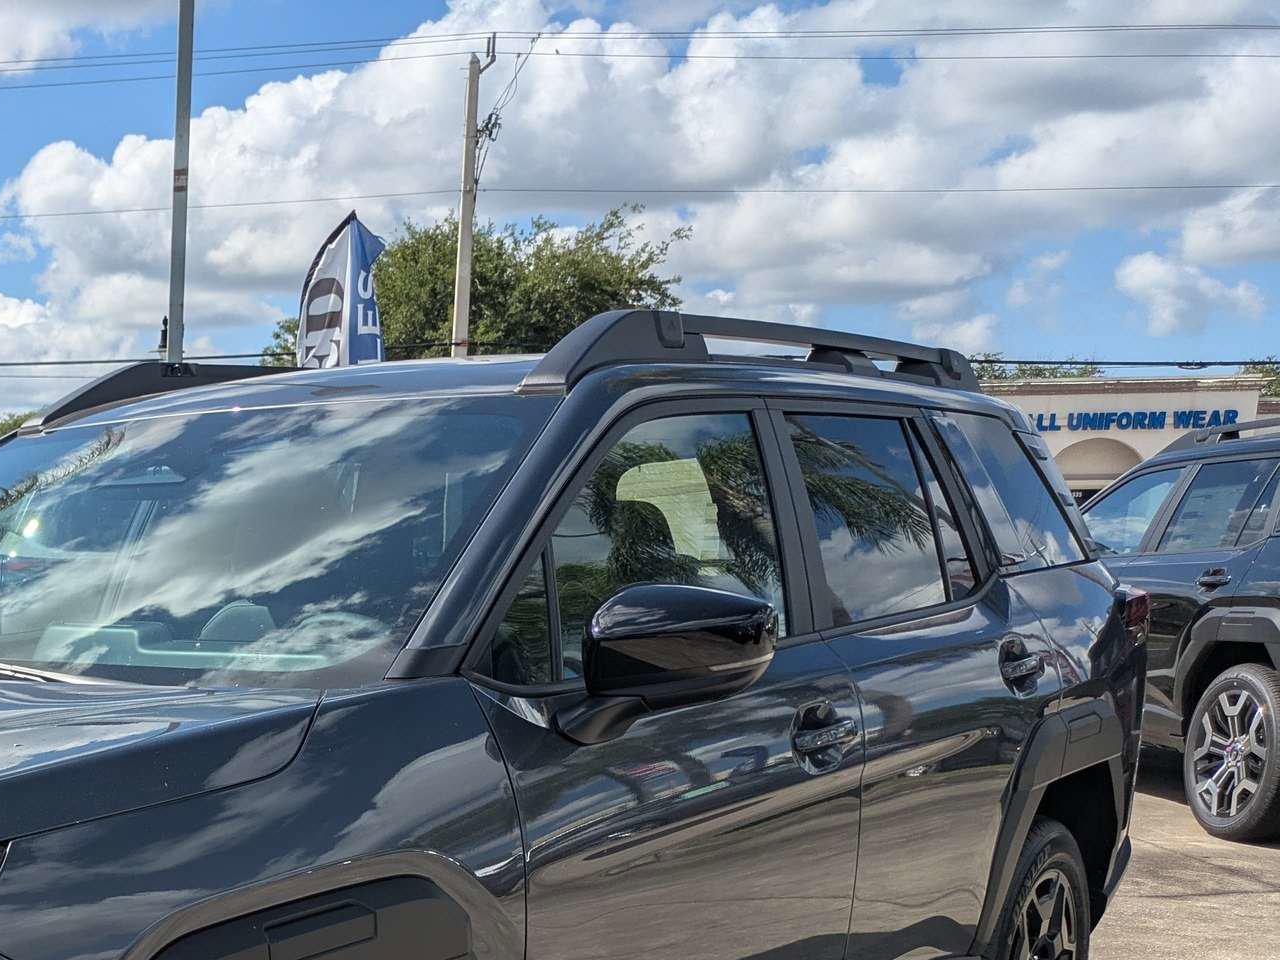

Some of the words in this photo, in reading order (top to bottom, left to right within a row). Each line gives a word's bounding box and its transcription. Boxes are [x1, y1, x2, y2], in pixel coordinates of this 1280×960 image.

[1029, 413, 1061, 432] LL
[1067, 411, 1167, 432] UNIFORM
[1173, 410, 1239, 429] WEAR
